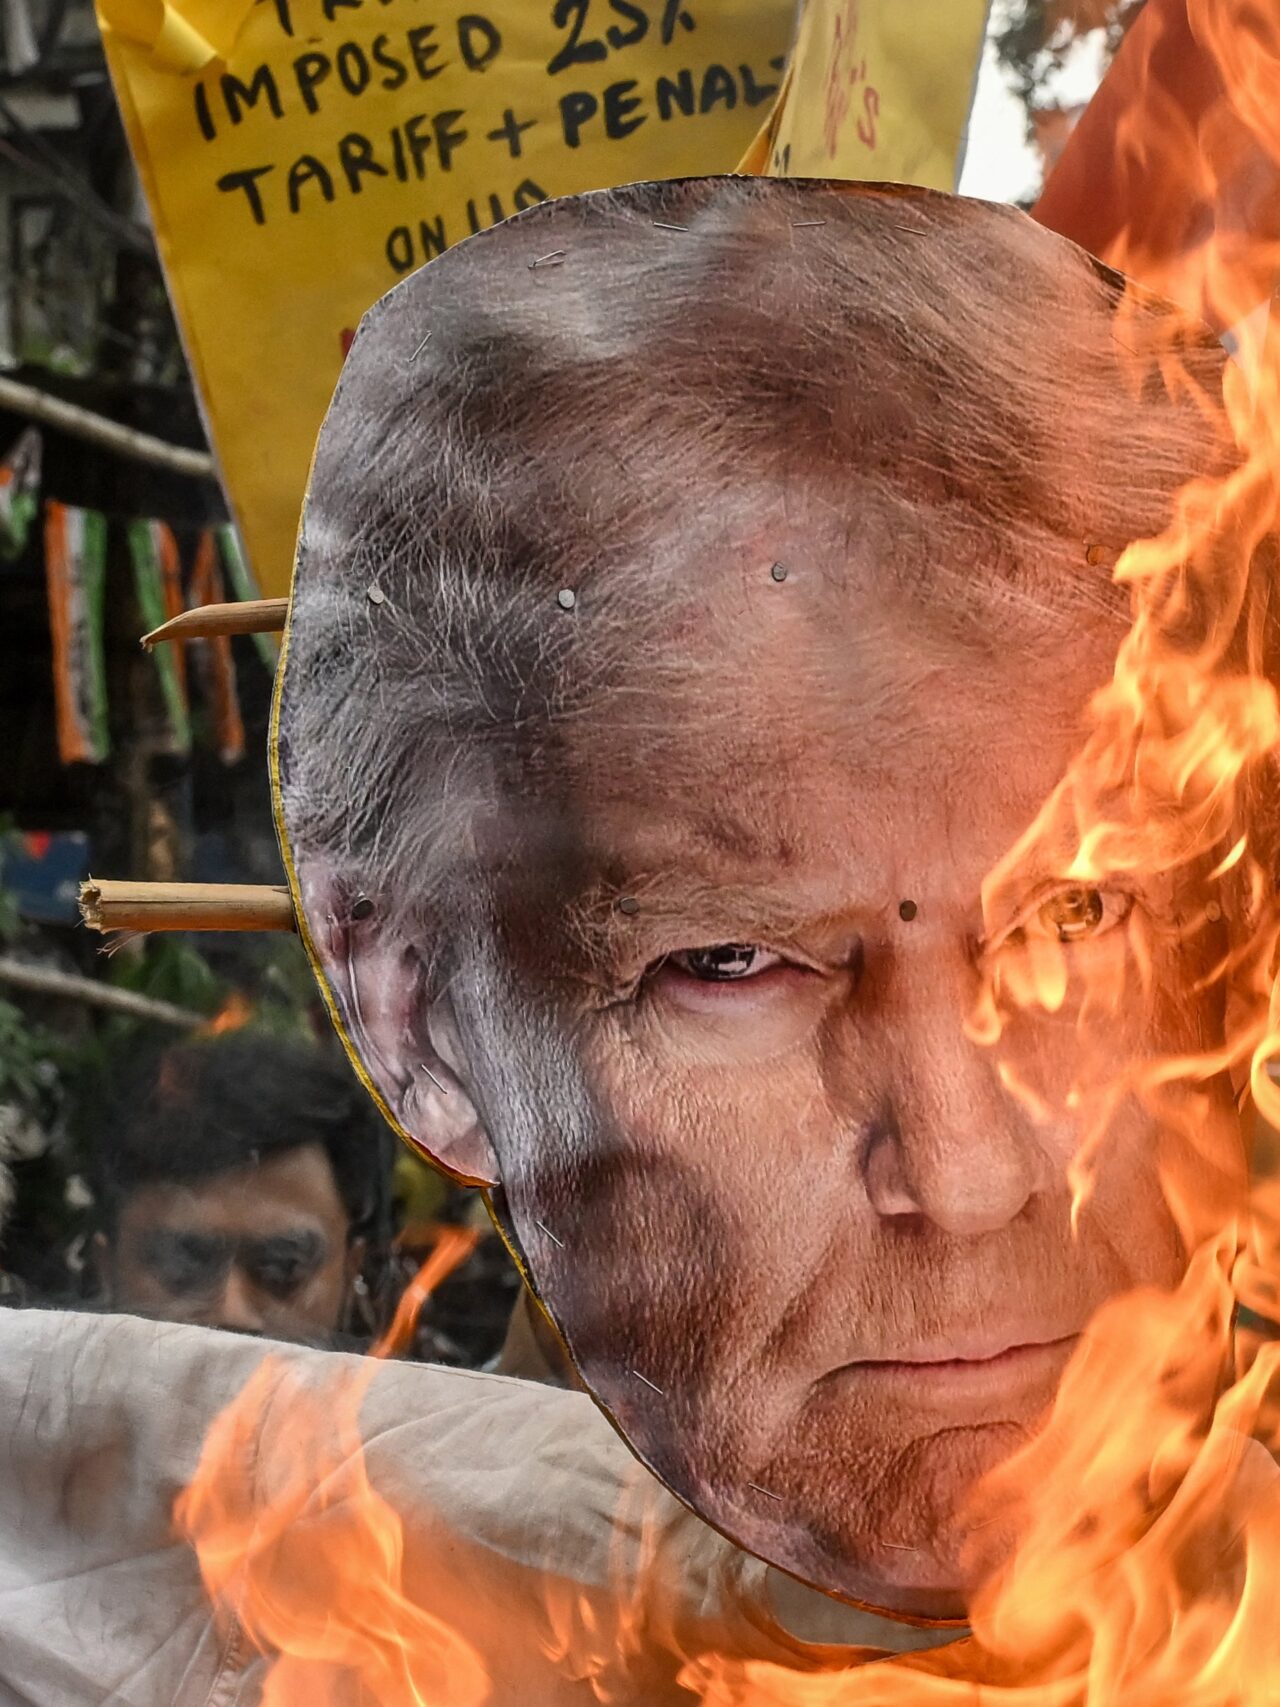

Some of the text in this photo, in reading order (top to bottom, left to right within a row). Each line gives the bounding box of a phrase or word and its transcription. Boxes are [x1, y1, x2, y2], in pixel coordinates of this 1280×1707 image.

[194, 14, 501, 140] IMPOSED
[216, 109, 467, 225] TARIFF
[487, 108, 537, 157] +
[560, 56, 786, 149] PENAL
[386, 215, 446, 273] ON
